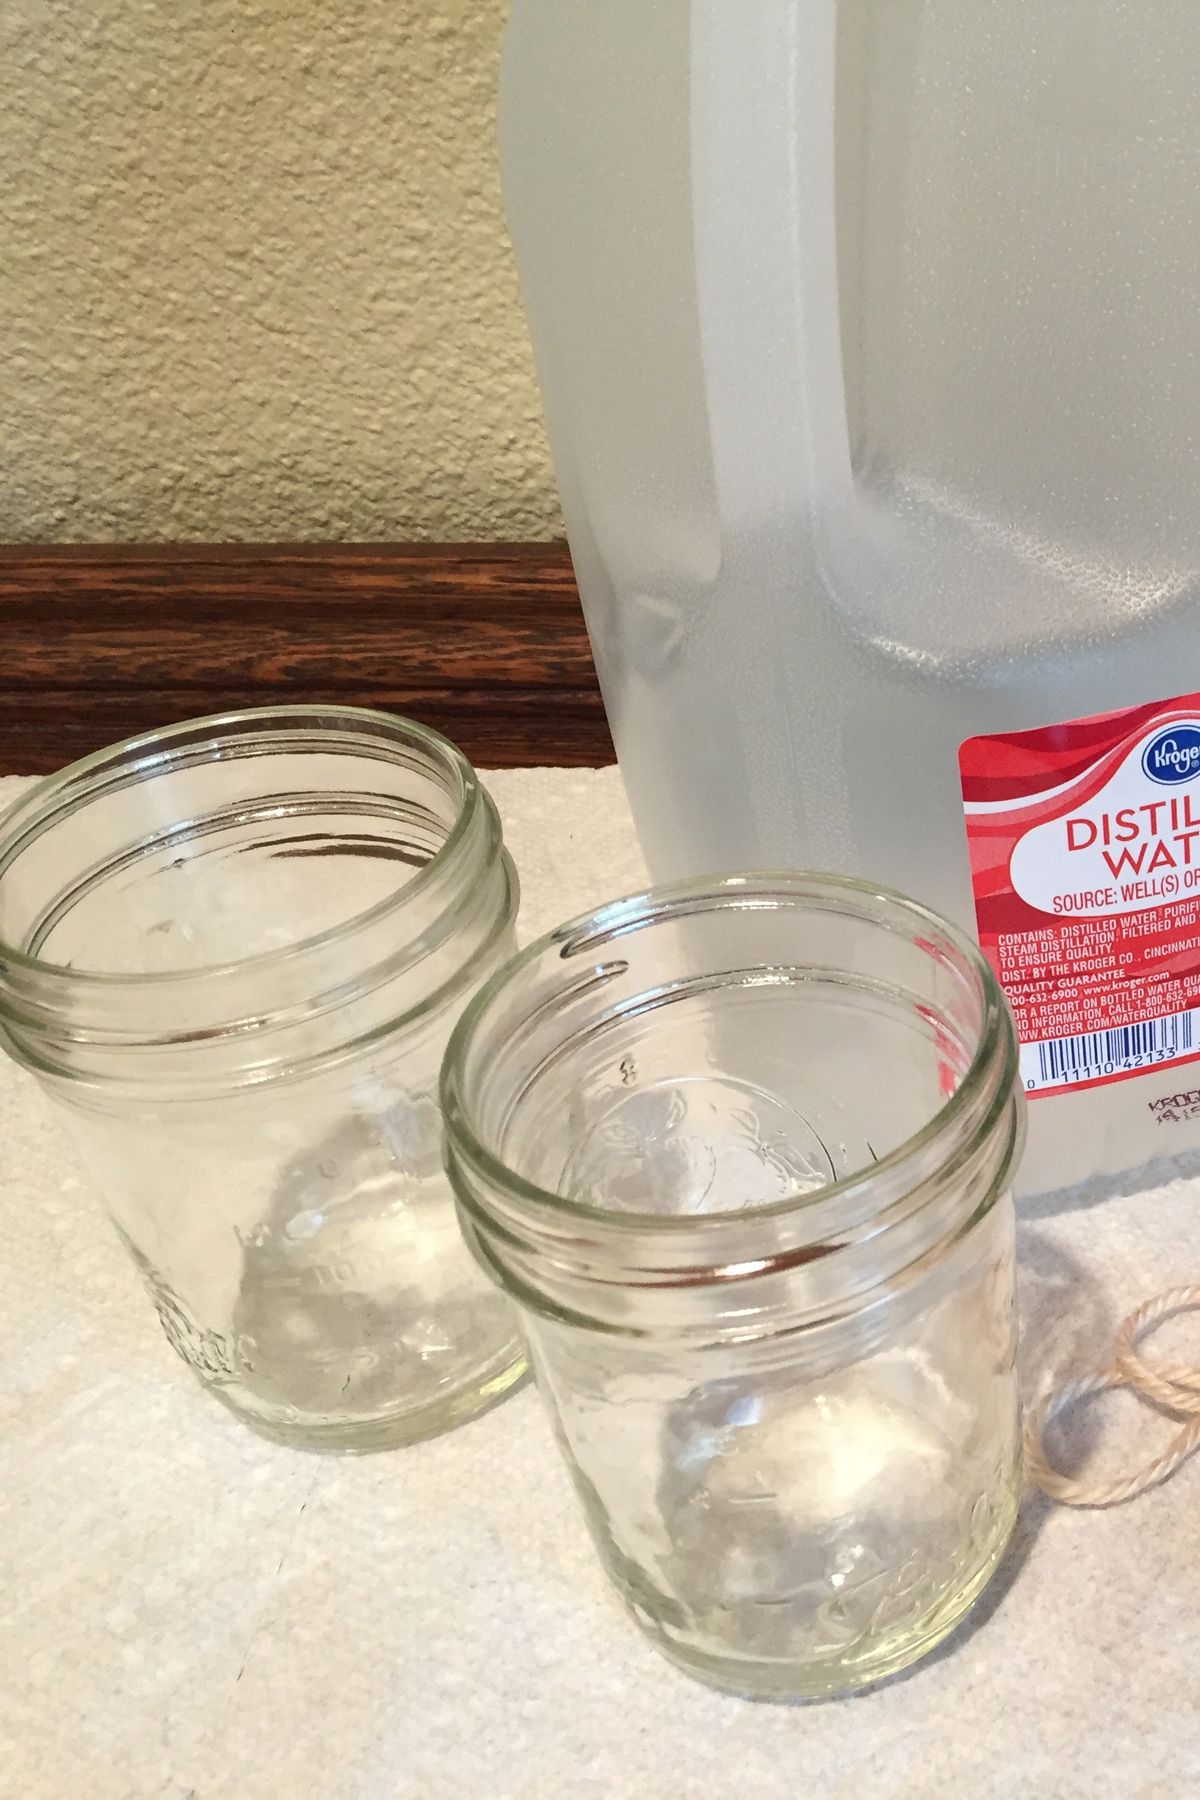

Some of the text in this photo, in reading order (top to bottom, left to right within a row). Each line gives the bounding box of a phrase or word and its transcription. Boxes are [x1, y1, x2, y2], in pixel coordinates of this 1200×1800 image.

[1053, 889, 1118, 912] SOURCE:
[1120, 873, 1180, 901] WELL(S)
[999, 931, 1058, 946] CONTAINS:
[1061, 919, 1117, 937] DISTILLED
[1000, 942, 1037, 958] STEAM
[1122, 919, 1171, 939] FILTERED
[1174, 912, 1195, 931] AND
[1001, 957, 1016, 968] TO
[1018, 950, 1061, 967] ENSURE
[1032, 966, 1047, 977] BY
[1049, 963, 1069, 977] THE
[1072, 955, 1115, 972] KROGER
[1003, 968, 1126, 996] QUALITY GUARANTEE
[1083, 971, 1170, 996] www.kroger.com
[1030, 1007, 1037, 1018] A
[1040, 1000, 1080, 1016] REPORT
[1083, 997, 1098, 1010] ON
[1100, 988, 1144, 1007] BOTTLED
[1146, 981, 1181, 997] WATER
[1108, 1002, 1133, 1016] CALL
[1027, 1079, 1036, 1089] 0
[1060, 1062, 1115, 1083] 11110
[1122, 1046, 1177, 1070] 42133
